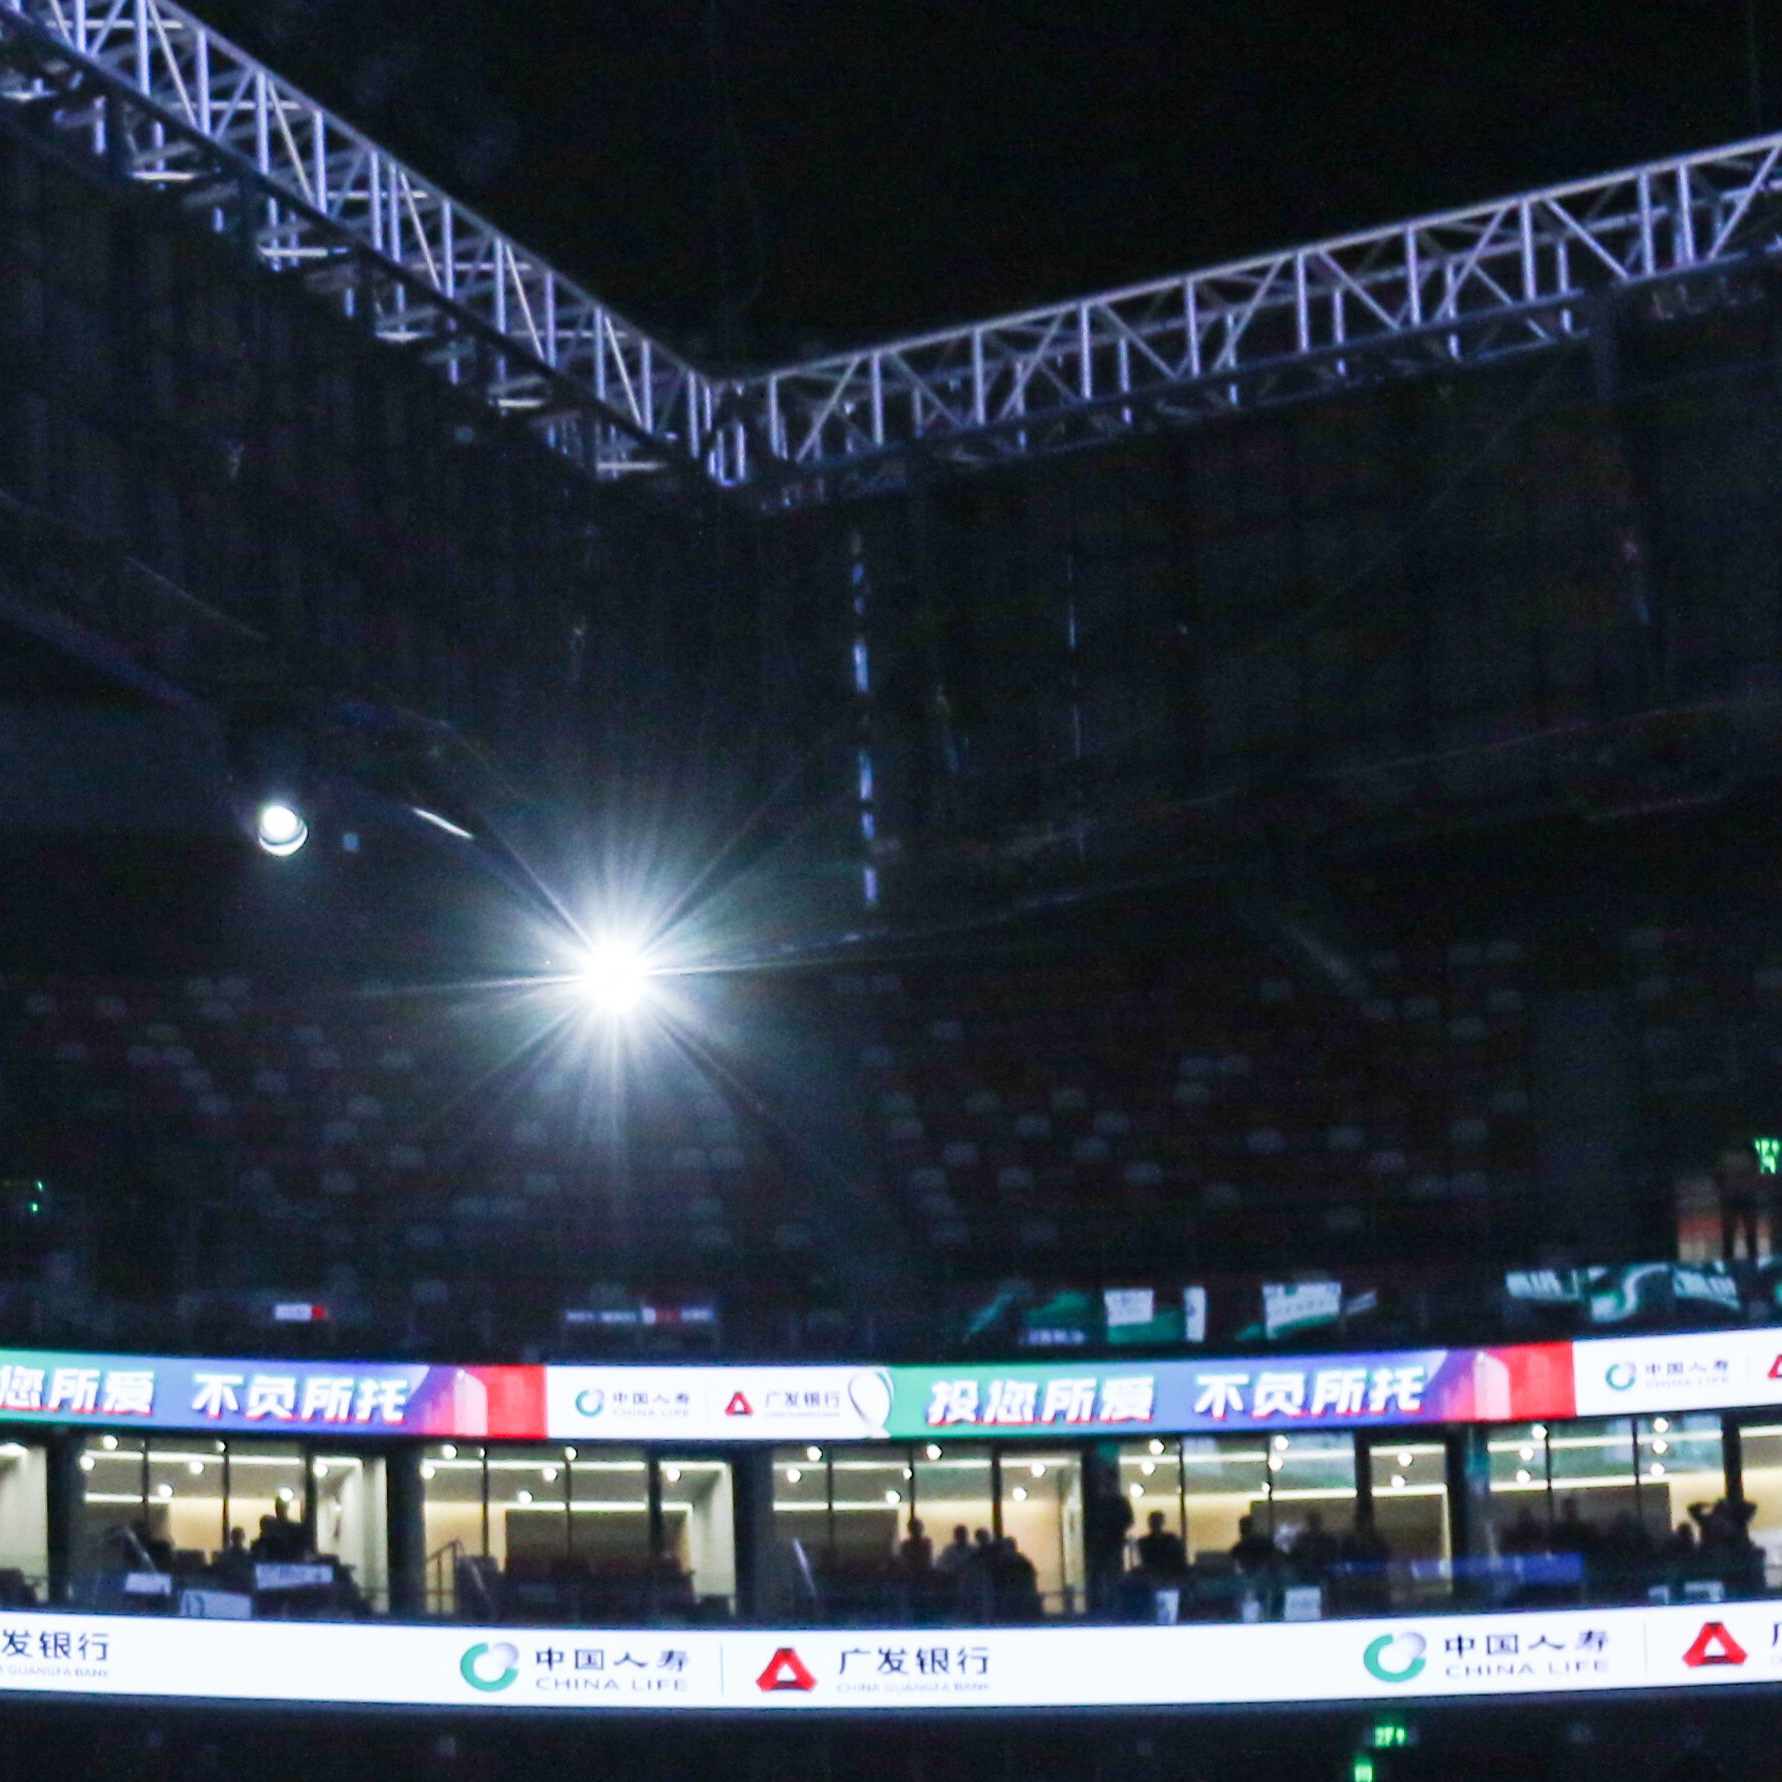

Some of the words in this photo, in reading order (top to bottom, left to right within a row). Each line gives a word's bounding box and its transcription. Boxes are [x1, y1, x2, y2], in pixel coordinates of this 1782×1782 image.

[192, 1372, 411, 1425] 不负所托
[765, 1390, 841, 1409] 广发银行
[926, 1374, 1157, 1427] 投您所爱
[1192, 1362, 1428, 1418] 不负所托
[1445, 1628, 1608, 1659] 中国人寿
[8, 1664, 73, 1678] GUANGFA
[75, 1667, 111, 1679] BANK
[535, 1645, 690, 1673] 中国人寿
[837, 1645, 991, 1676] 广发银行
[1445, 1662, 1536, 1680] CHINA
[1548, 1659, 1610, 1675] LIFE
[535, 1676, 621, 1693] CHINA
[632, 1676, 689, 1693] LIFE
